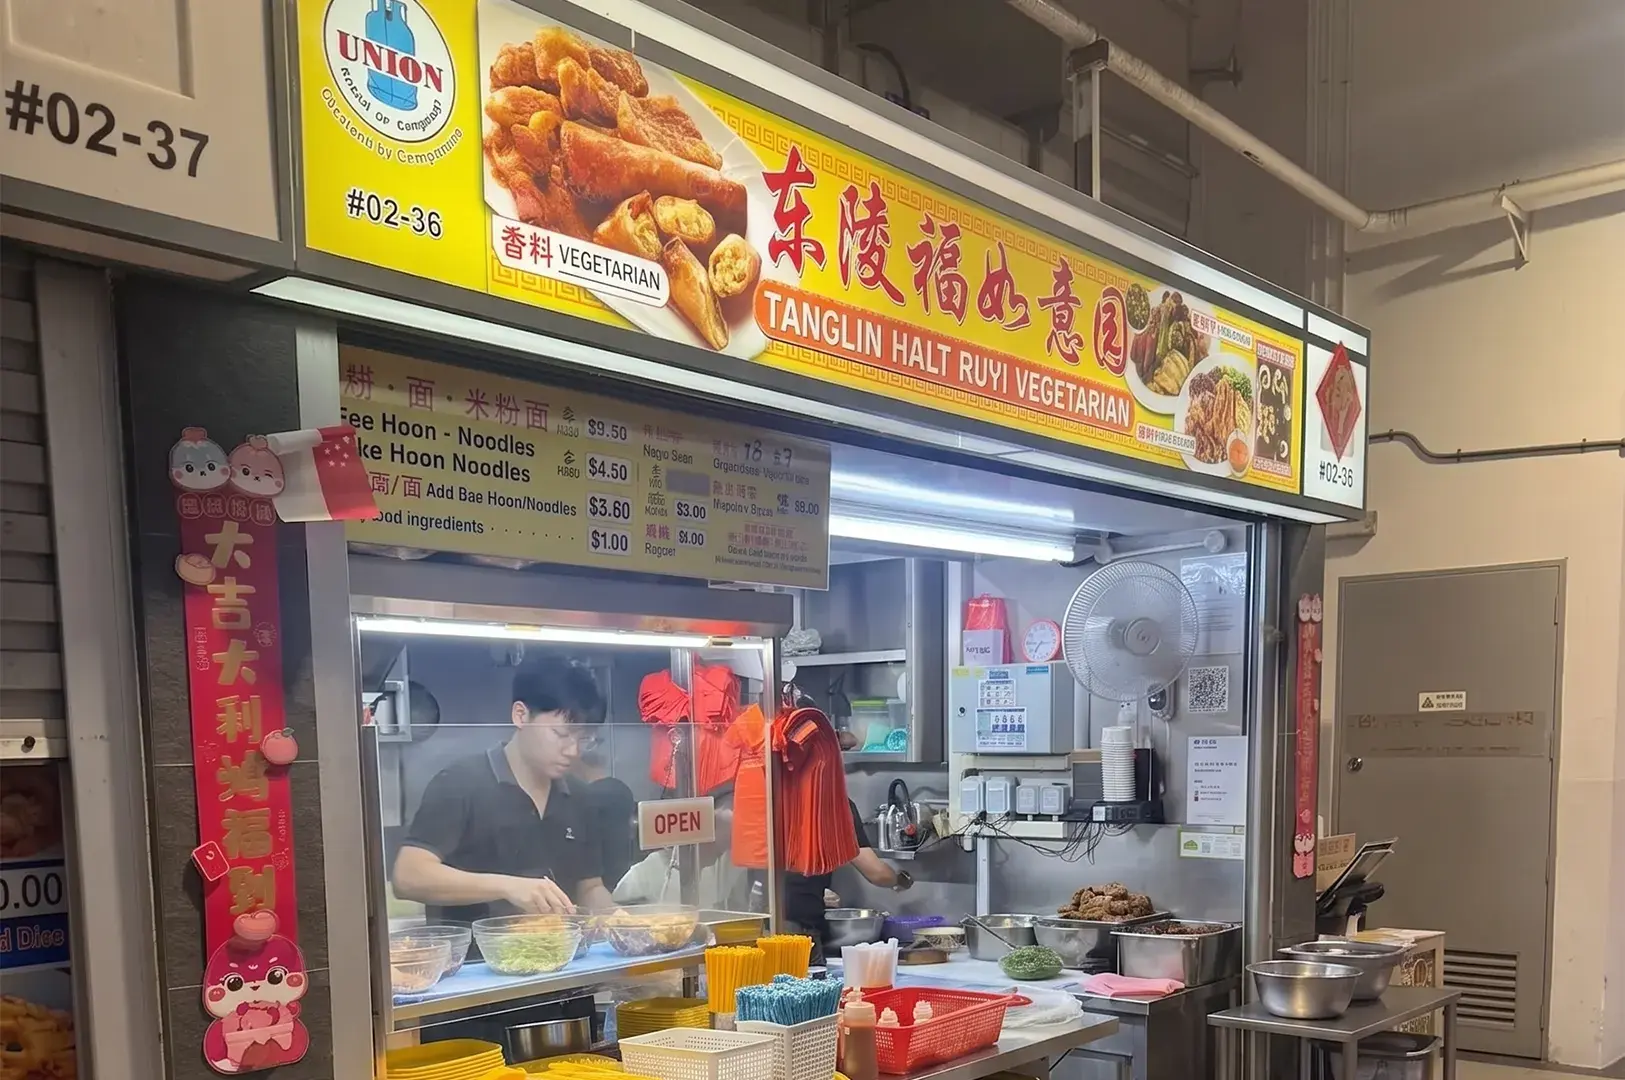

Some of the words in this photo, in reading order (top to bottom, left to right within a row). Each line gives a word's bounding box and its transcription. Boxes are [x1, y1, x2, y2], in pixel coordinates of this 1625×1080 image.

[337, 29, 443, 93] UNION
[5, 80, 209, 178] #02-37
[347, 189, 442, 237] #02-36
[559, 244, 660, 291] VEGETARIAN
[763, 291, 883, 358] TANGLIN
[892, 331, 952, 376] HALT
[959, 351, 1007, 394] RUYI
[1016, 369, 1130, 428] VEGETARIAN
[382, 412, 436, 440] Hoon
[458, 426, 535, 457] Noodles
[588, 418, 627, 441] $9.50
[391, 442, 444, 470] Hoon
[452, 453, 530, 482] Noodles
[589, 457, 627, 481] $4.50
[1319, 460, 1353, 488] #02-36
[426, 482, 454, 500] Add
[459, 486, 483, 504] Bae
[487, 490, 577, 516] Hoon/Noodles
[589, 496, 630, 520] $3.60
[677, 502, 706, 519] $3.00
[407, 511, 484, 534] ingredients
[591, 529, 628, 552] $1.00
[655, 811, 701, 834] OPEN
